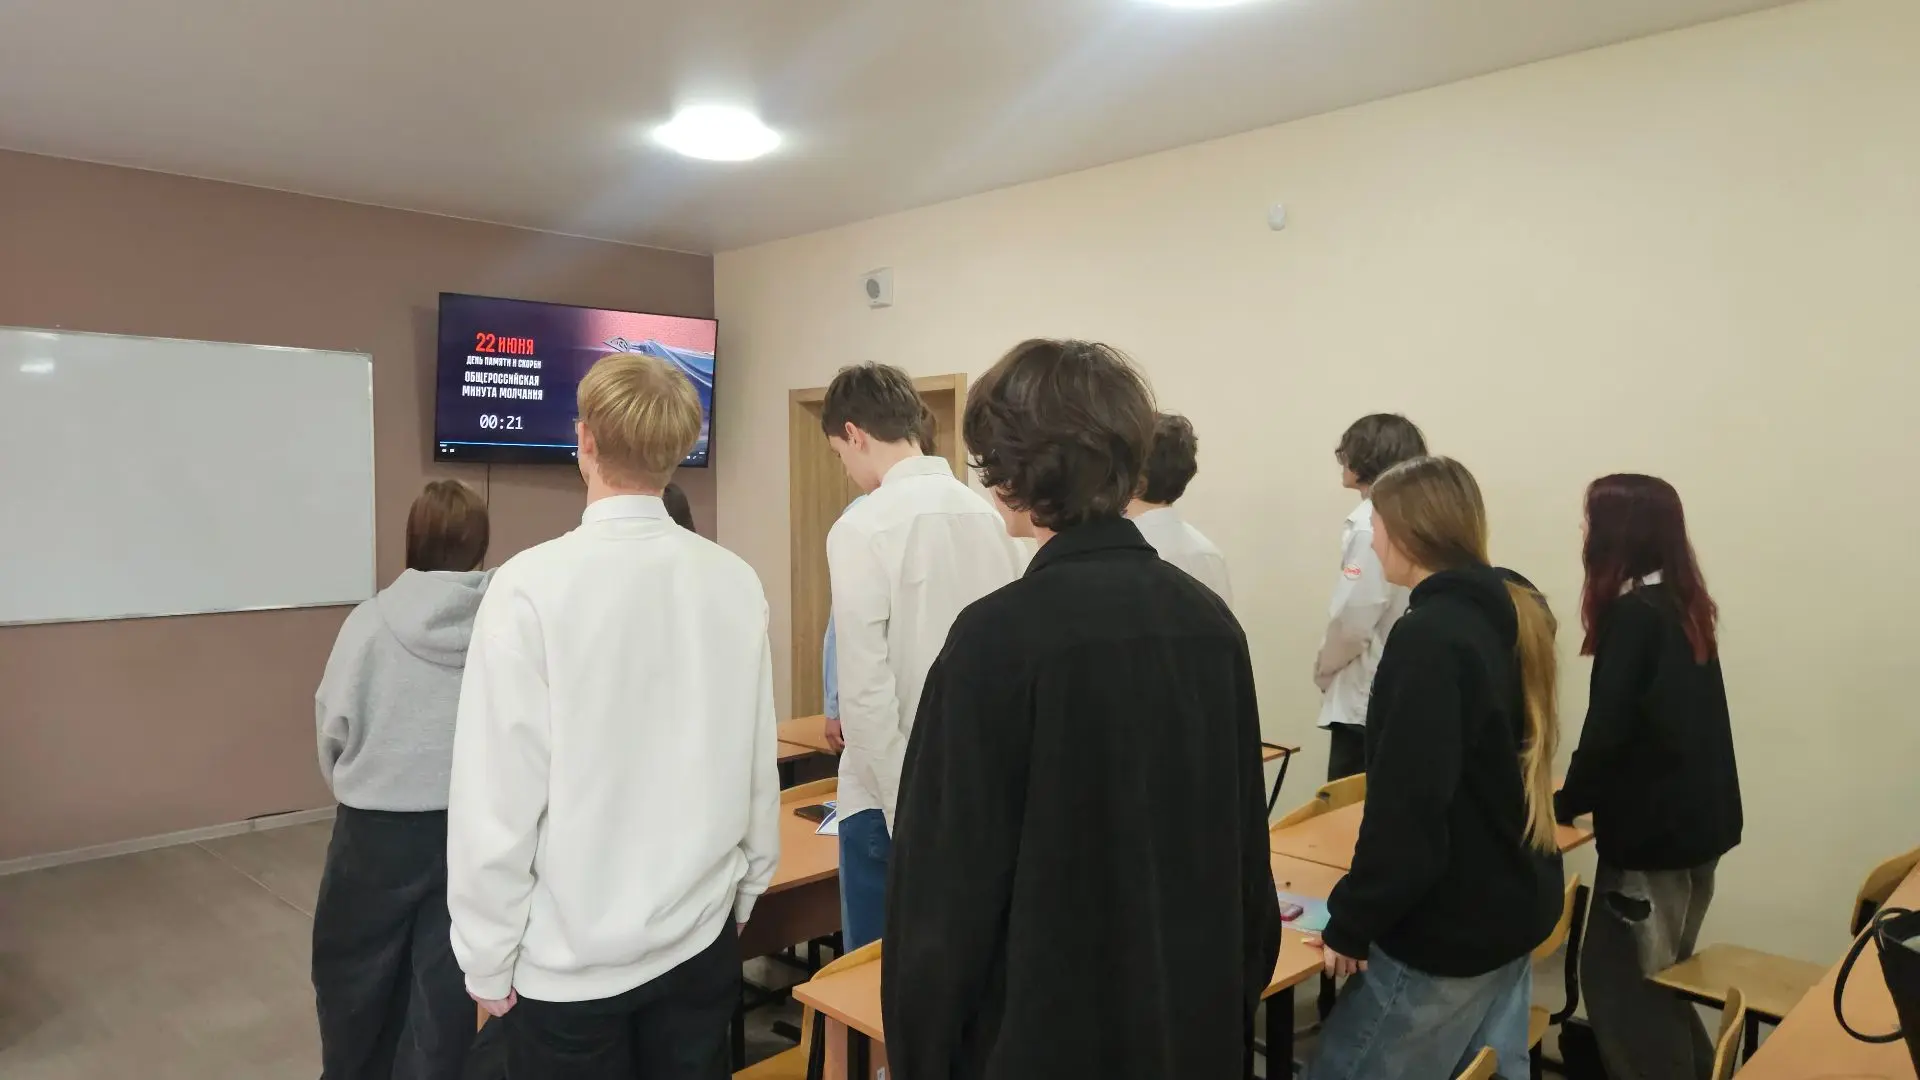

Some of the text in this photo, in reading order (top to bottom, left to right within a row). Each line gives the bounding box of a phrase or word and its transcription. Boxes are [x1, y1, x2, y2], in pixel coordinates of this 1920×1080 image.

[476, 332, 534, 355] 22 ИЮНЯ
[466, 356, 483, 365] ДЕНЬ
[484, 356, 511, 367] ПАМЯТИ
[518, 359, 542, 369] СКОРБИ
[464, 371, 540, 386] ОБЩЕРОССИЙСКАЯ
[462, 385, 543, 400] МИНУТА МОЛЧАНИЯ
[480, 414, 523, 429] 00:21
